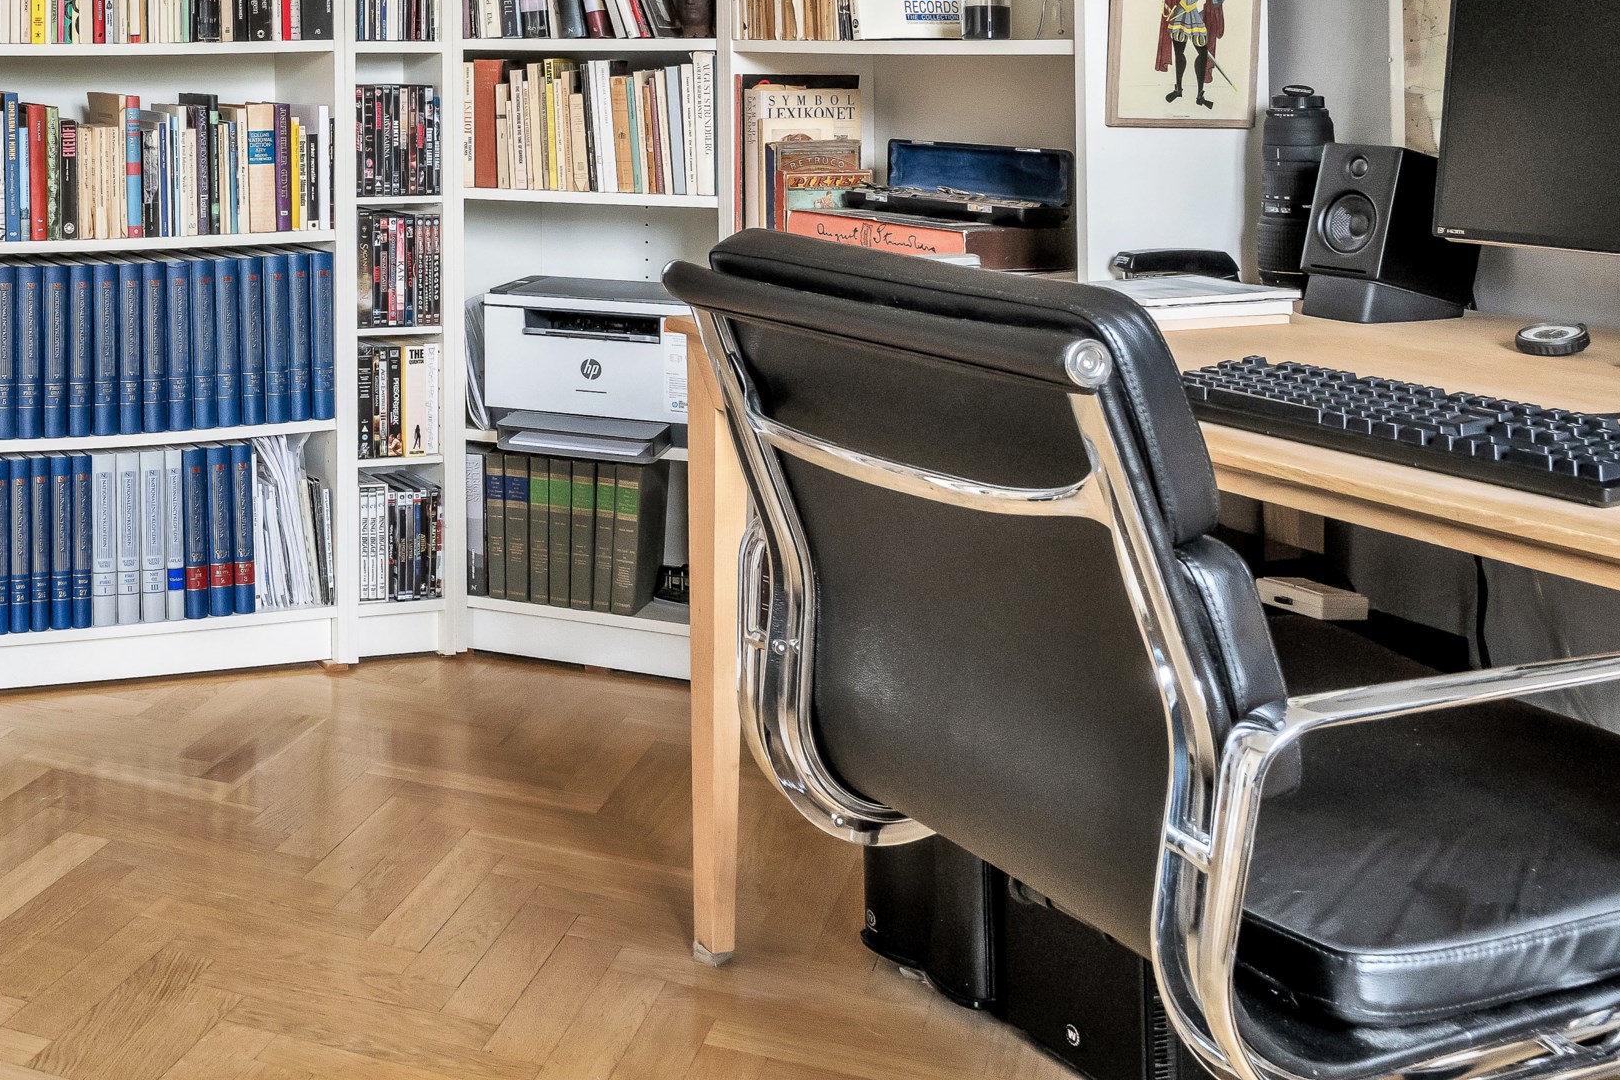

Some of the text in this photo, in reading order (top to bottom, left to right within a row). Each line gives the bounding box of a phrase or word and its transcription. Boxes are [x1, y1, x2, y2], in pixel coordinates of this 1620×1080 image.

[905, 0, 959, 14] RECORDS
[767, 95, 855, 107] SYMBOL
[702, 63, 712, 156] AUGUST STRINDBERG
[767, 107, 856, 120] LEXIKONET
[789, 157, 846, 170] RETRUCO
[360, 243, 368, 267] SAGAN
[409, 350, 424, 359] THE
[583, 359, 599, 380] hp
